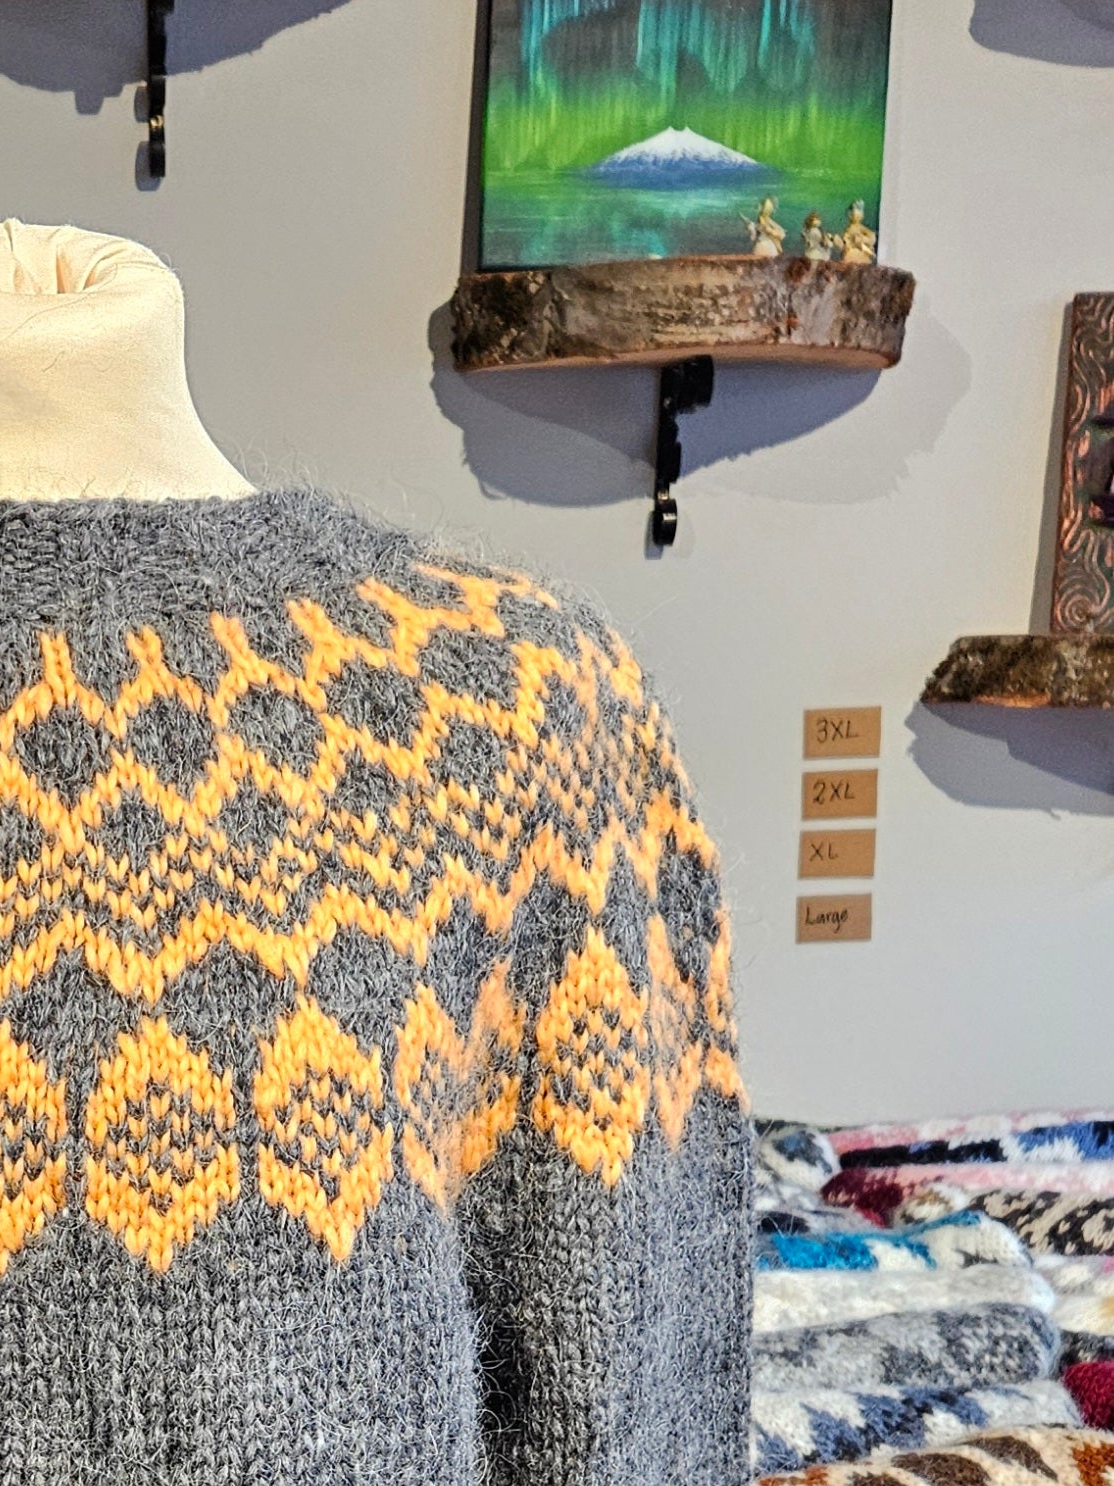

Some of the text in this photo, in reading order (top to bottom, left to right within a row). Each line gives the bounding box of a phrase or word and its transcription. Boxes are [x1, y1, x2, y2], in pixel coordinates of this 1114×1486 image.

[816, 717, 859, 744] 3XL
[812, 780, 855, 805] 2XL
[809, 842, 839, 861] XL
[805, 906, 848, 934] Large
